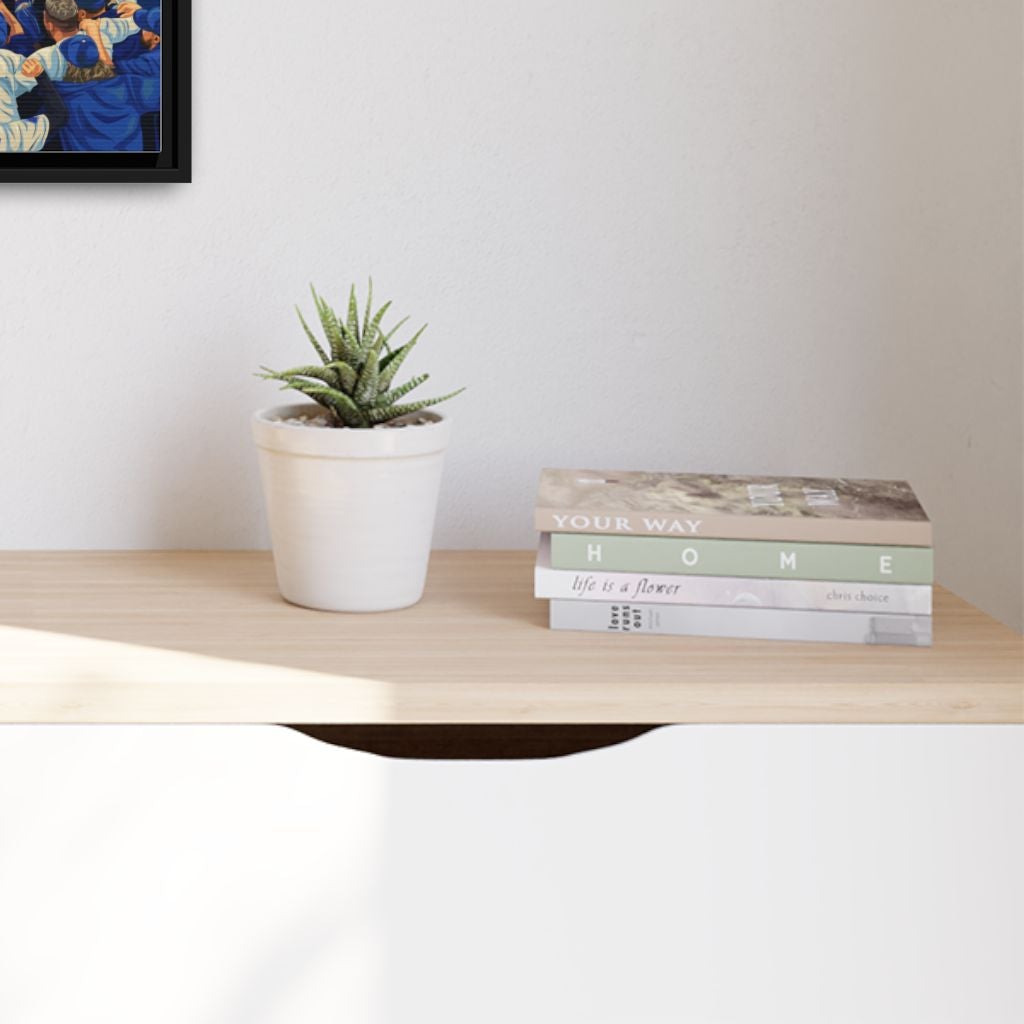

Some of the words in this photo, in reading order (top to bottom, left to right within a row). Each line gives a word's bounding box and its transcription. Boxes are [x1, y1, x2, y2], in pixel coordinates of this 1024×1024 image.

[552, 514, 633, 531] YOUR
[643, 518, 703, 533] WAY
[572, 575, 596, 597] life
[602, 579, 615, 592] is
[619, 582, 629, 593] a
[631, 578, 682, 598] flower
[826, 588, 852, 601] chris
[854, 590, 890, 603] choice
[608, 605, 619, 629] love
[622, 605, 630, 631] runs
[632, 608, 641, 628] out
